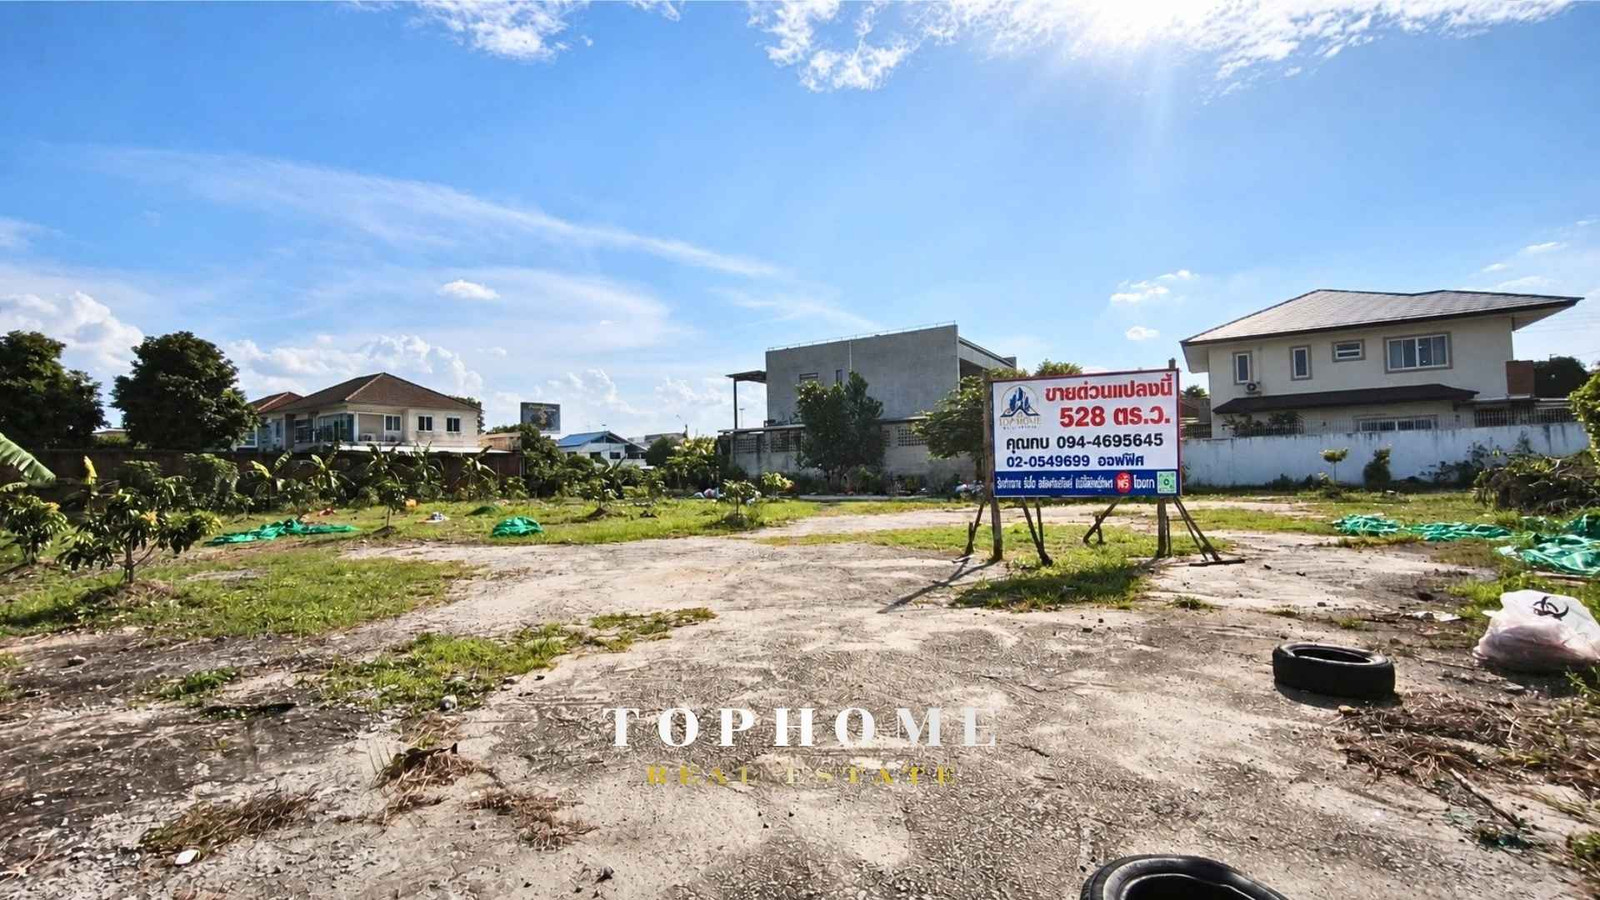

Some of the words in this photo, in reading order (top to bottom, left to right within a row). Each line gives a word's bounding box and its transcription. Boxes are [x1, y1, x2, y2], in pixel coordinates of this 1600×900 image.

[1045, 374, 1172, 401] ขายด่วนแปลงนี้
[1060, 406, 1105, 427] 528
[1113, 406, 1170, 425] ตร.ว.
[1057, 433, 1163, 448] 094-4695645
[1006, 455, 1090, 468] 02-0549699
